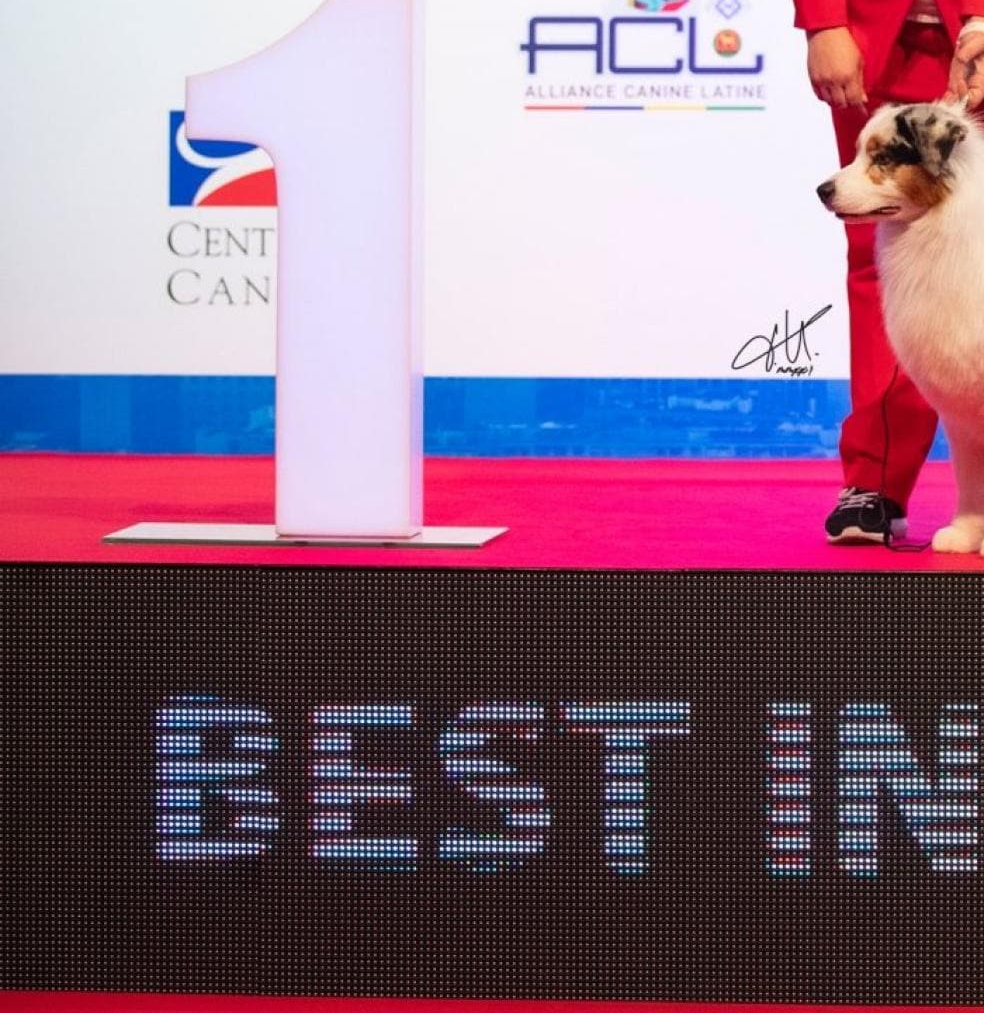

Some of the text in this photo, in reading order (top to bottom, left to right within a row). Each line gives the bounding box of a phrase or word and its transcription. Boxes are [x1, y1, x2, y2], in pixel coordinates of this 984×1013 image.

[520, 16, 764, 74] ACL
[525, 85, 766, 100] ALLIANCE CANINE LATINE
[166, 220, 275, 258] CENT
[166, 267, 271, 306] CAN
[155, 694, 691, 874] BEST
[766, 701, 980, 877] IN
